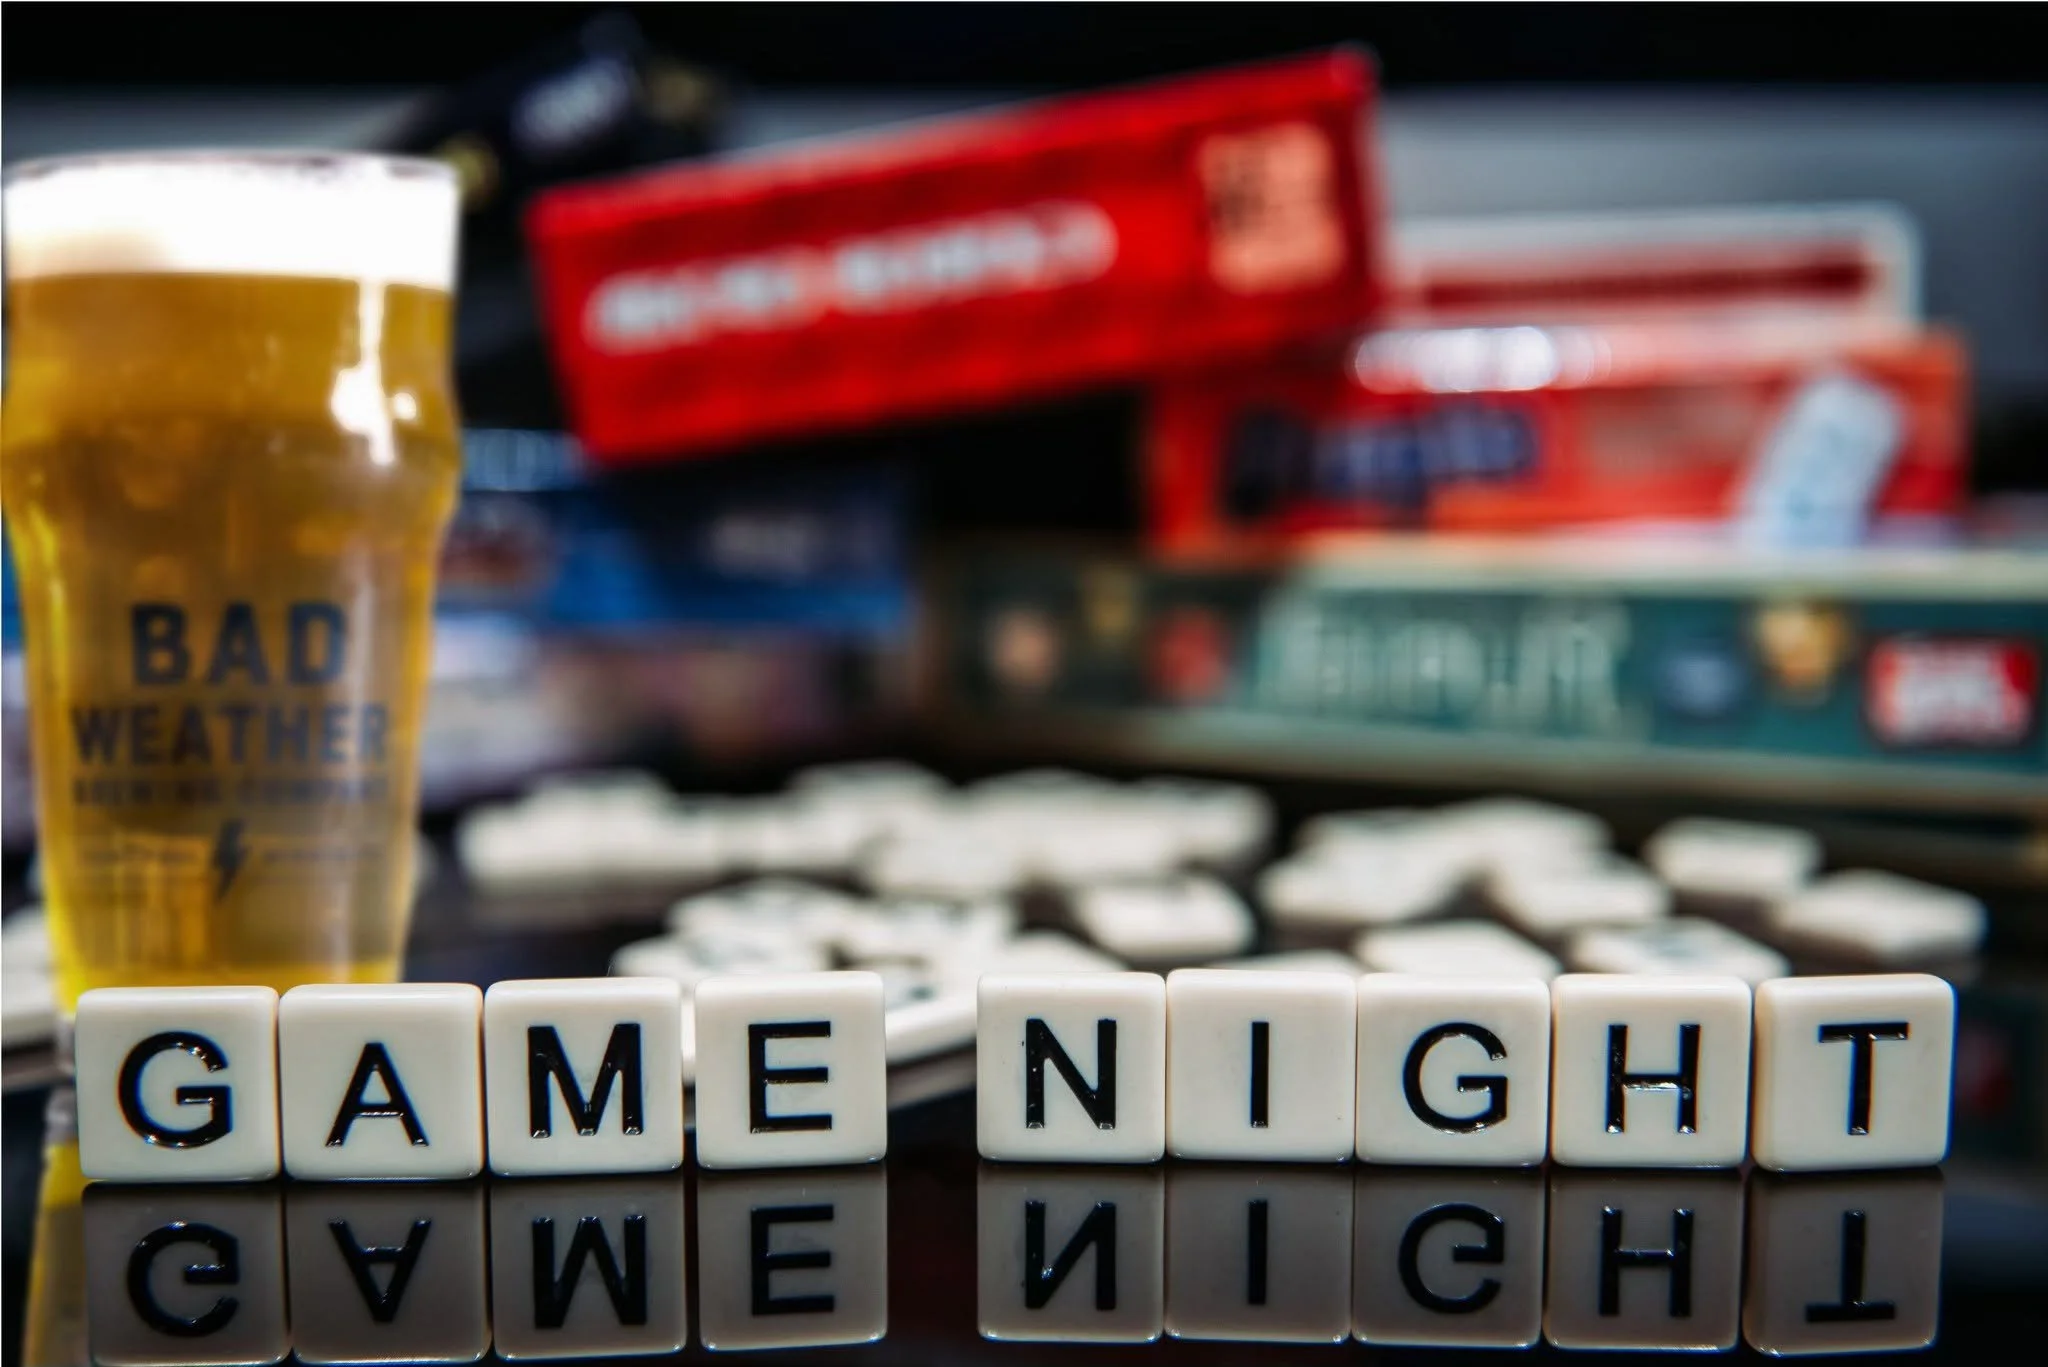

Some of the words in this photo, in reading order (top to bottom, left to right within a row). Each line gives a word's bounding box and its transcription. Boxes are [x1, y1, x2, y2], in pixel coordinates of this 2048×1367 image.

[132, 602, 349, 687] BAD
[70, 704, 390, 767] WEATHER
[118, 1020, 833, 1149] GAME
[1024, 1018, 1910, 1136] NIGHT
